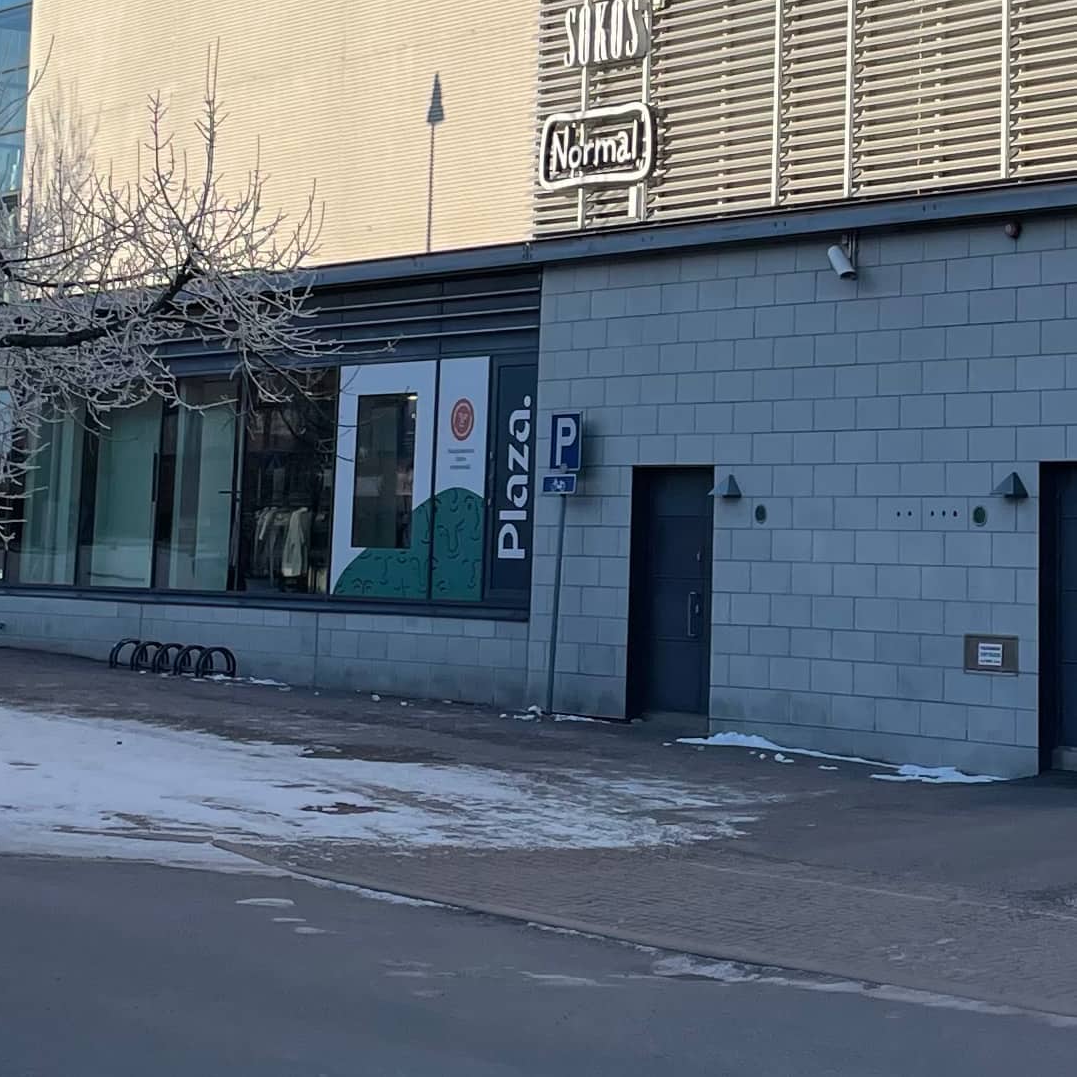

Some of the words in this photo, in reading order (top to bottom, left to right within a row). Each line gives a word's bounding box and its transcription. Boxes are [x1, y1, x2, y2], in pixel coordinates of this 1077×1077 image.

[551, 119, 638, 172] Normal
[555, 417, 577, 467] P
[498, 395, 531, 559] Plaza.
